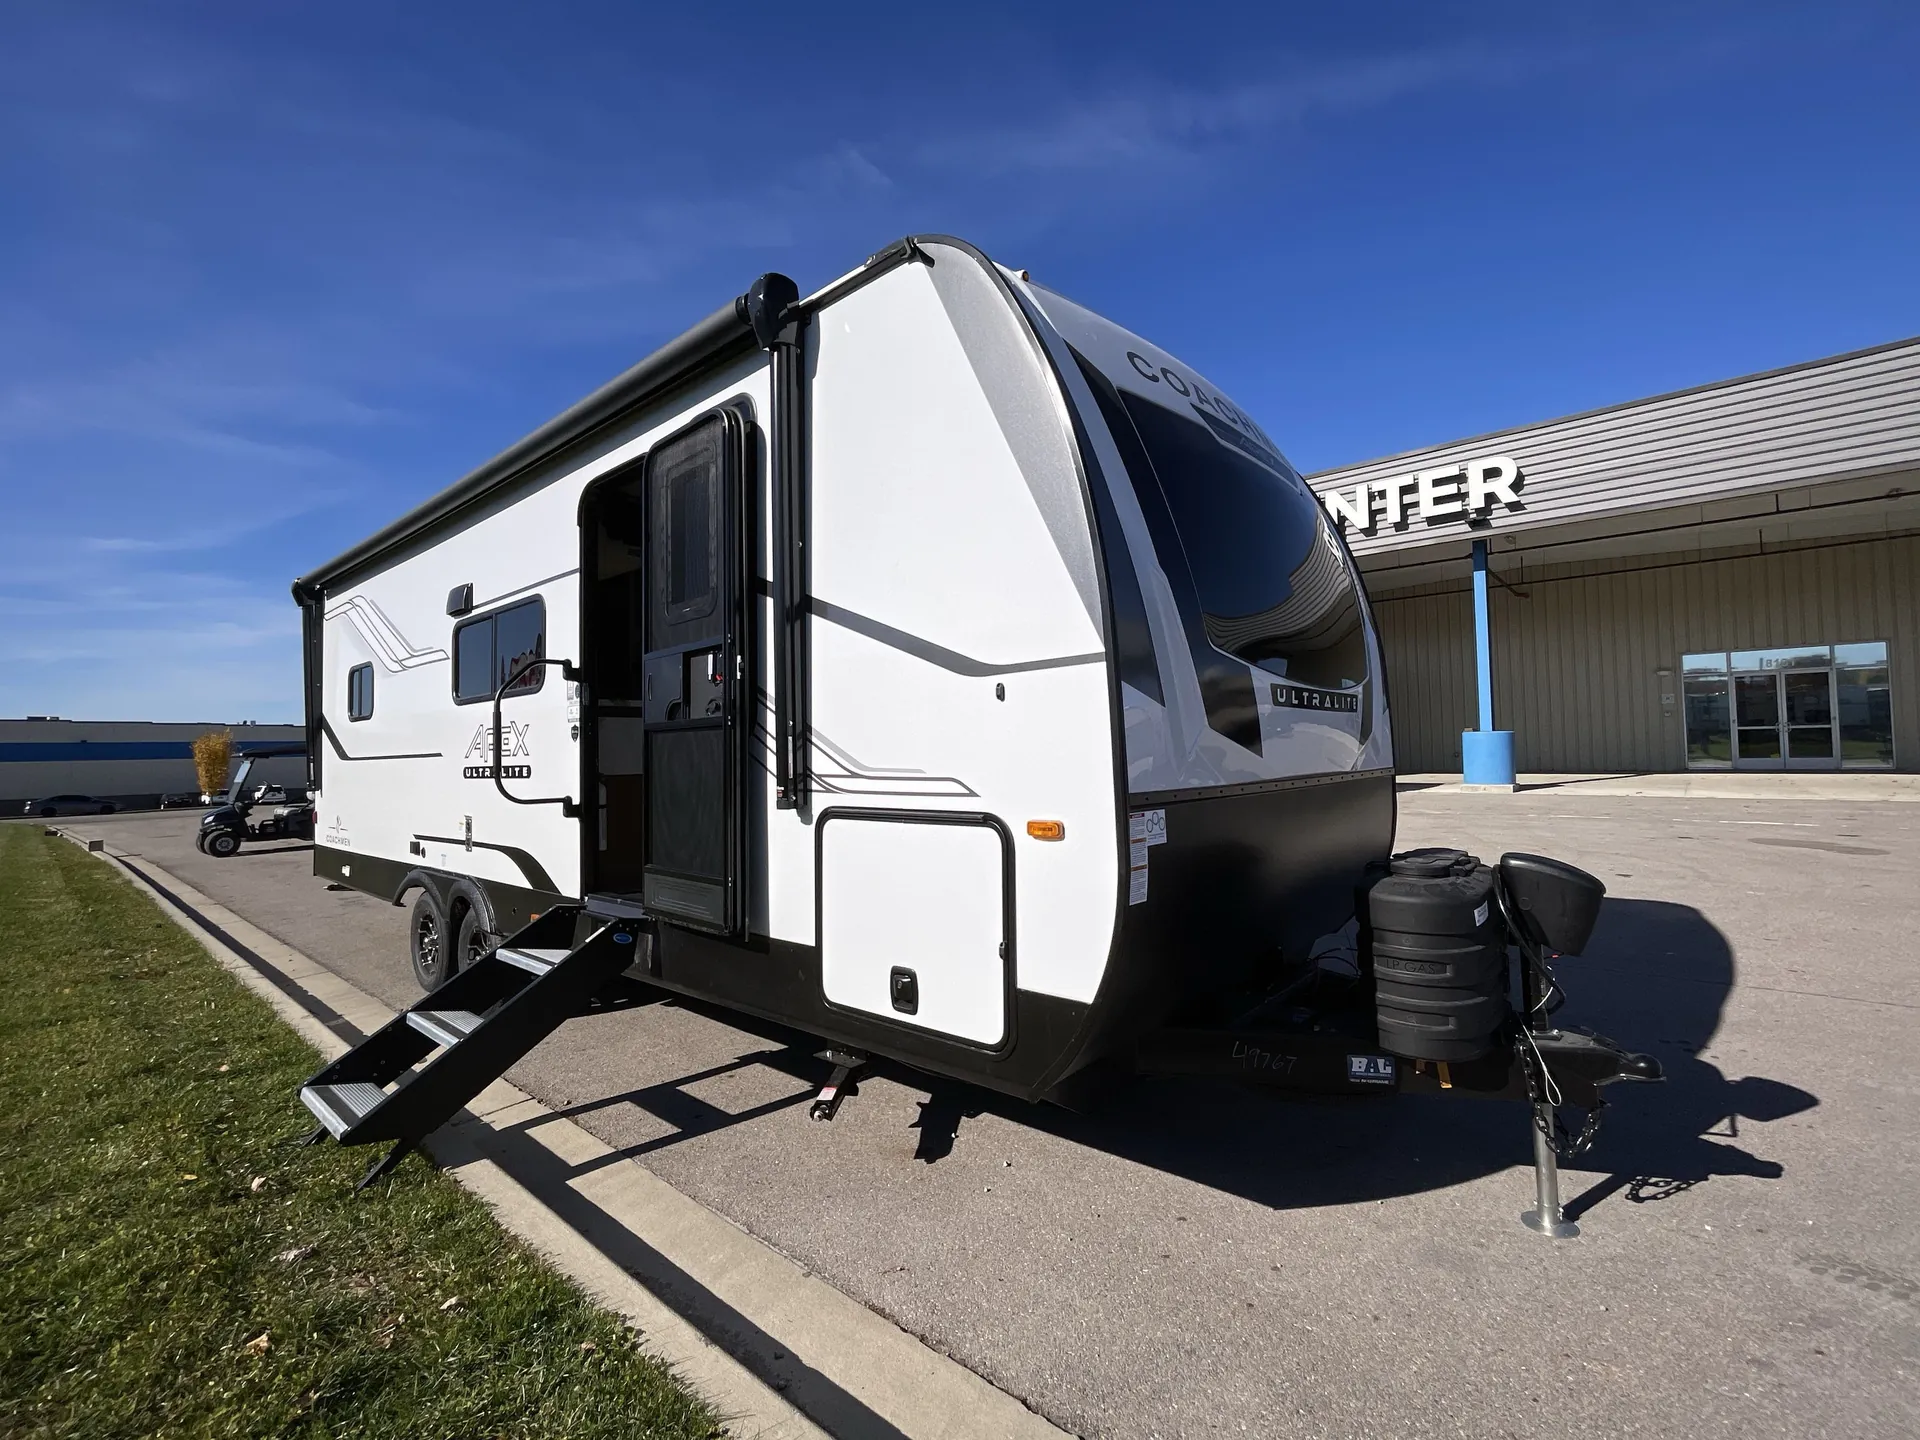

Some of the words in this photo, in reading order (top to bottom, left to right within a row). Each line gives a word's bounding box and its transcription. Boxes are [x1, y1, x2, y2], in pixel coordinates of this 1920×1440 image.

[1127, 351, 1284, 461] COACH
[1324, 456, 1521, 530] NTER
[1277, 688, 1357, 709] ULTRALITE
[465, 721, 530, 763] APEX
[465, 767, 528, 777] ULTRLITE
[1386, 959, 1400, 970] LP
[1404, 962, 1436, 975] GAS
[1352, 1057, 1392, 1074] BAL
